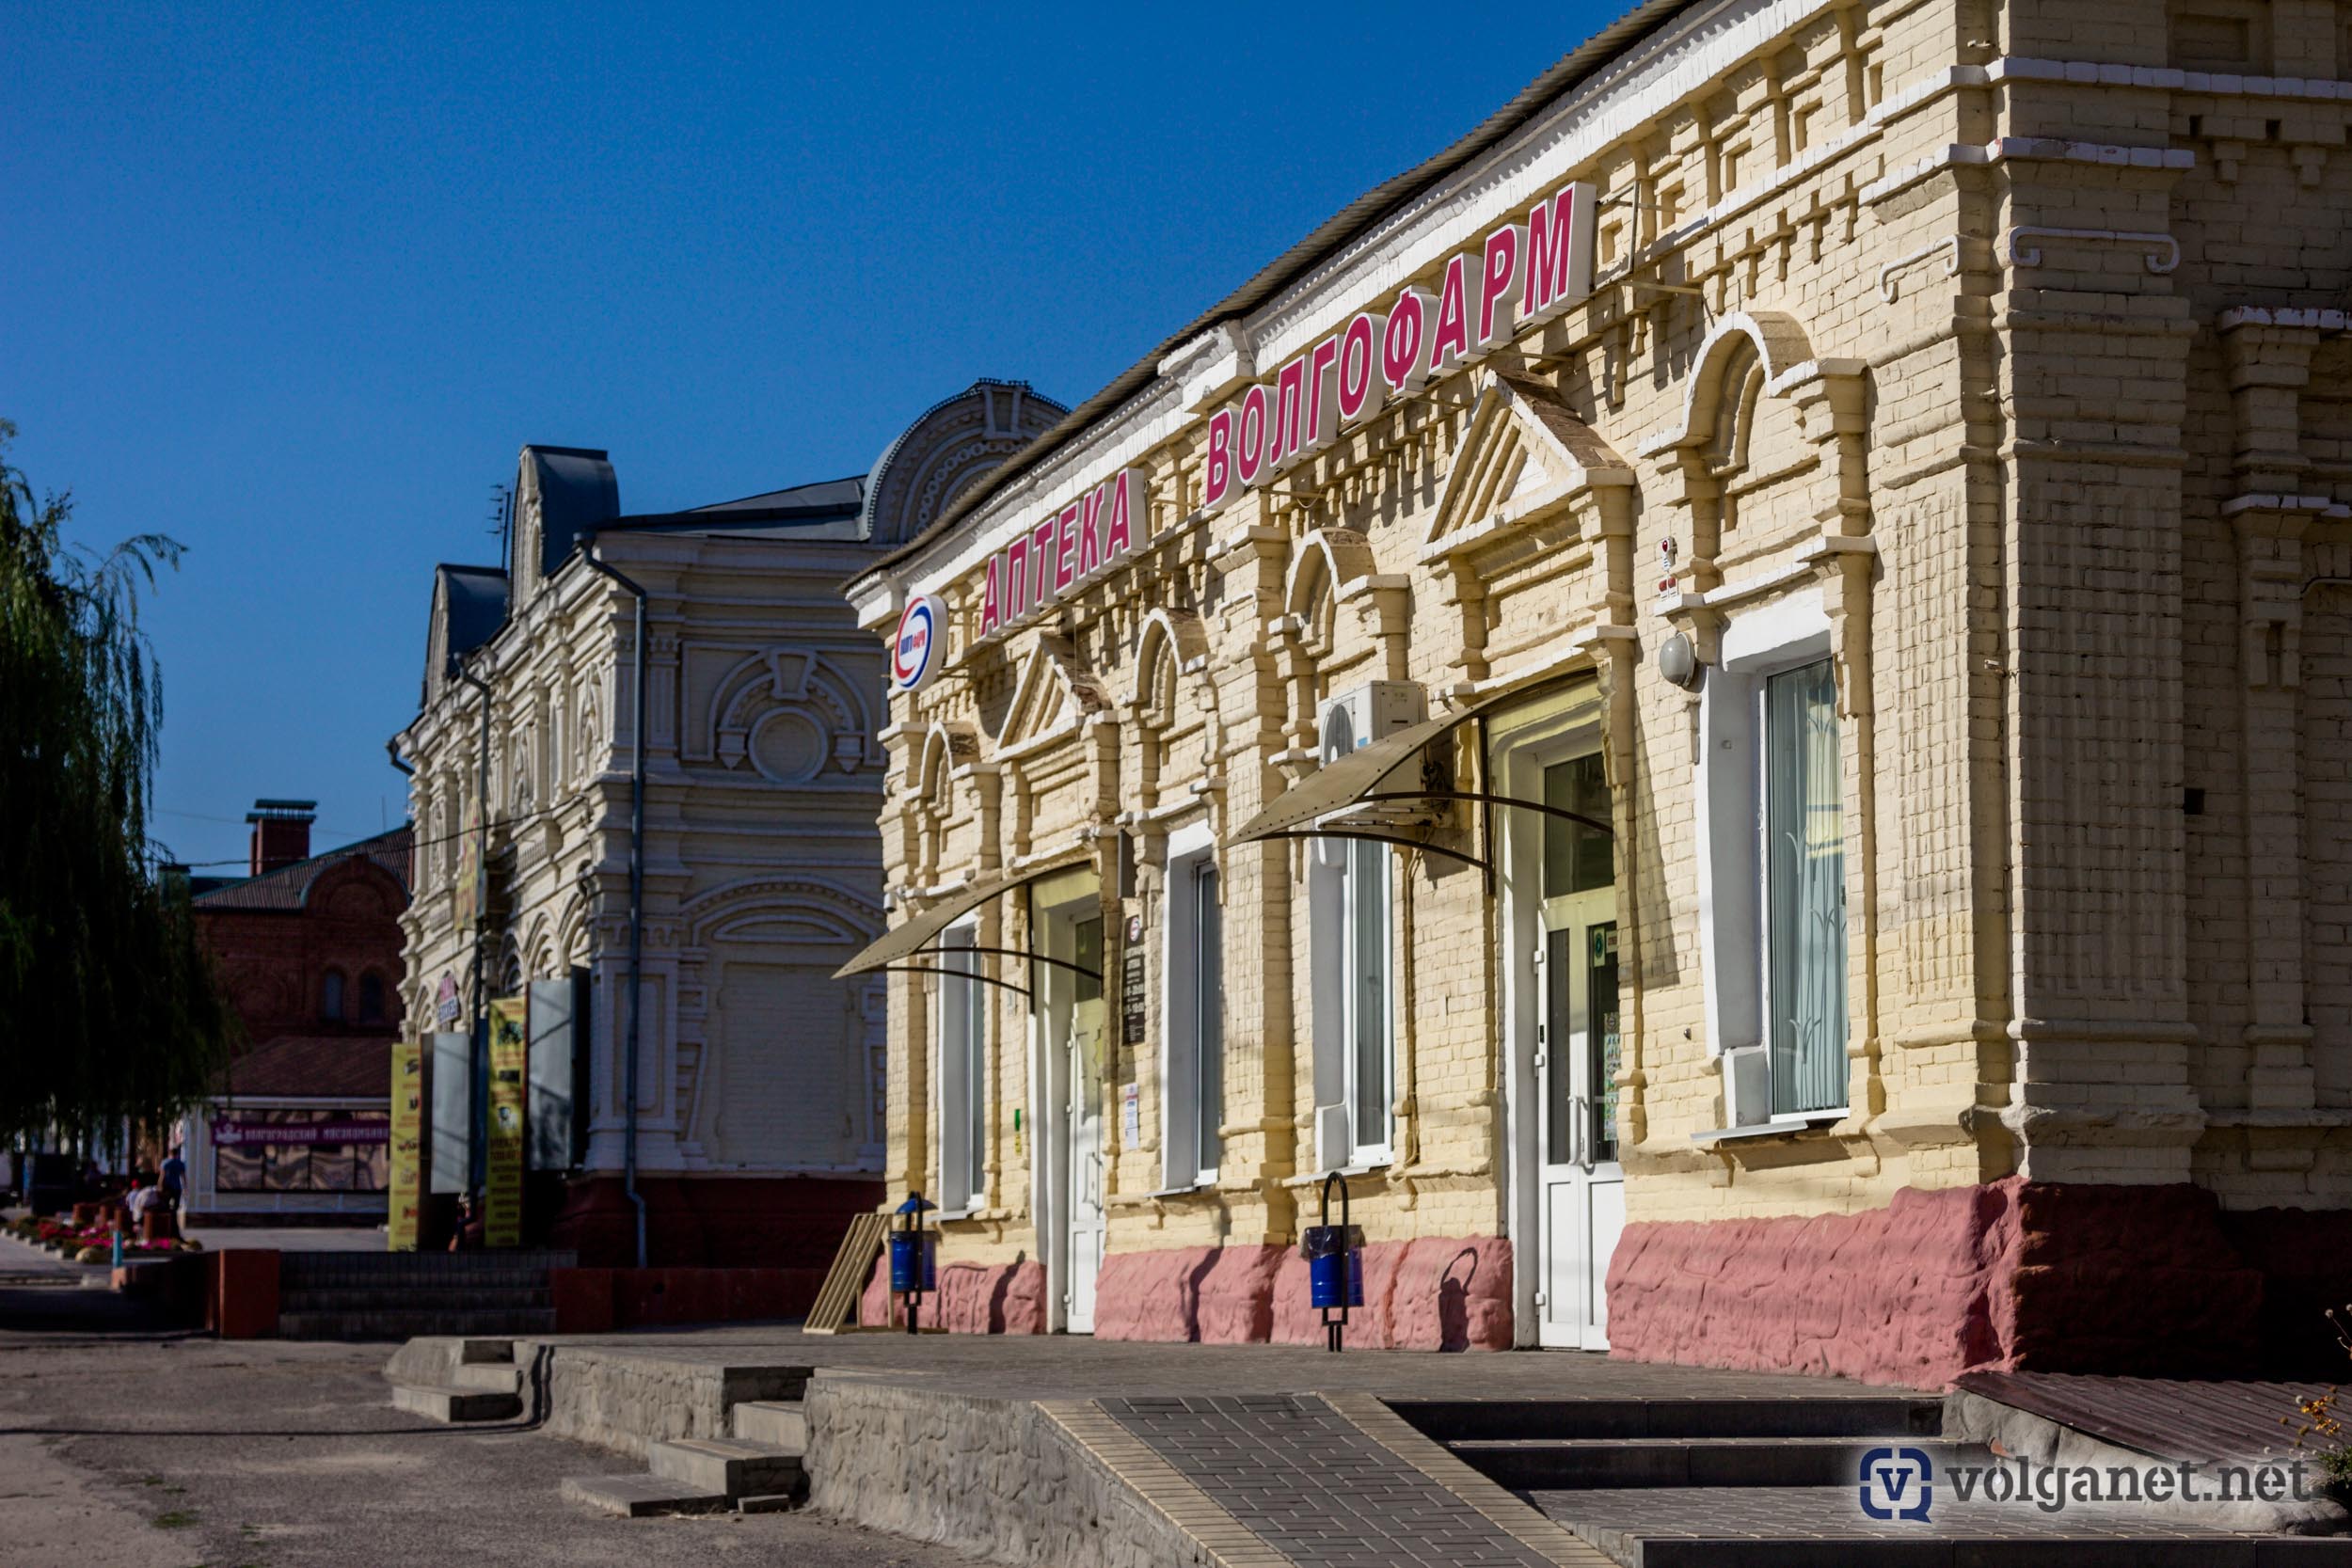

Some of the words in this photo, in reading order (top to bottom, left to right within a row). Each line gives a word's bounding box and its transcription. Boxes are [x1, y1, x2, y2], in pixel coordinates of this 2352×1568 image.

[1205, 182, 1576, 511] ВОЛГОФАРМ
[979, 470, 1132, 641] АПТЕКА
[323, 1127, 389, 1141] МЯСОКОМБИНА
